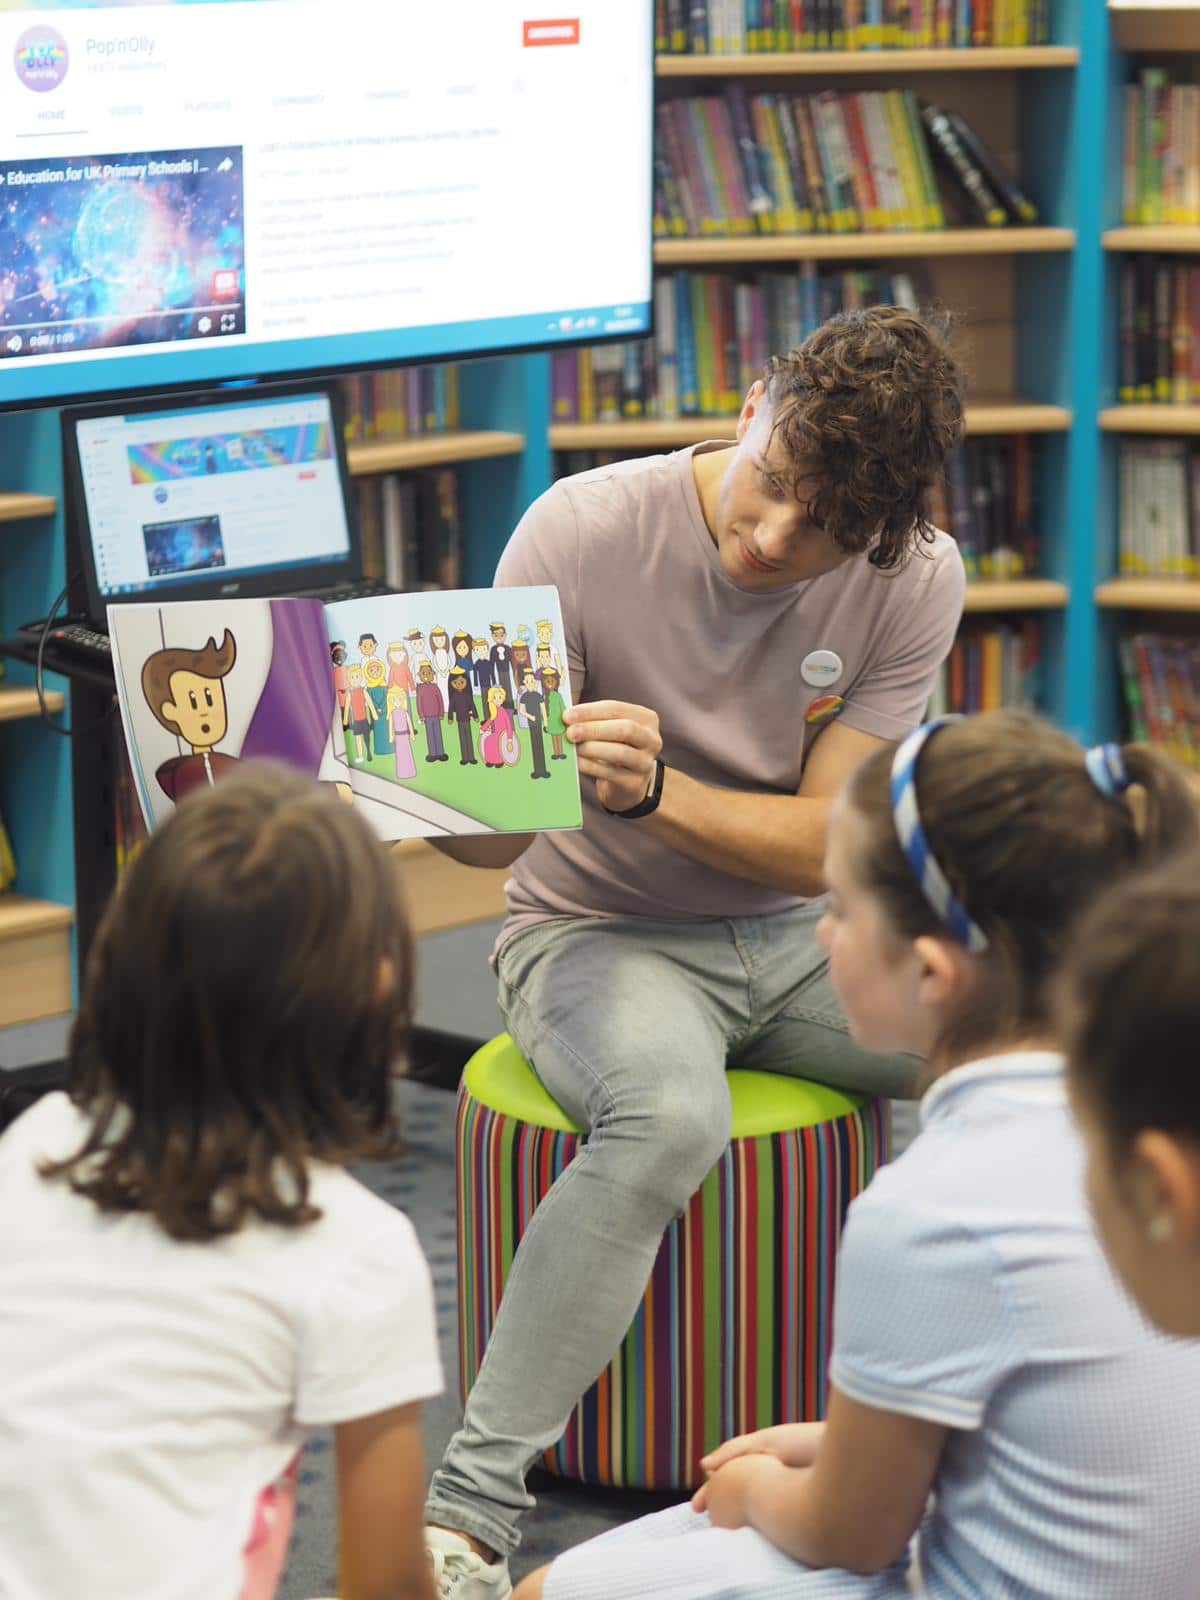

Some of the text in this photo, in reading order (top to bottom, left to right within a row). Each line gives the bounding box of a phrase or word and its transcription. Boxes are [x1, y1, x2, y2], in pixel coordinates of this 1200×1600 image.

[86, 36, 155, 56] Pop'n'Olly
[7, 168, 64, 185] Education
[66, 166, 82, 181] for
[84, 166, 103, 180] UK
[103, 163, 147, 184] Primary
[148, 160, 193, 176] Schools
